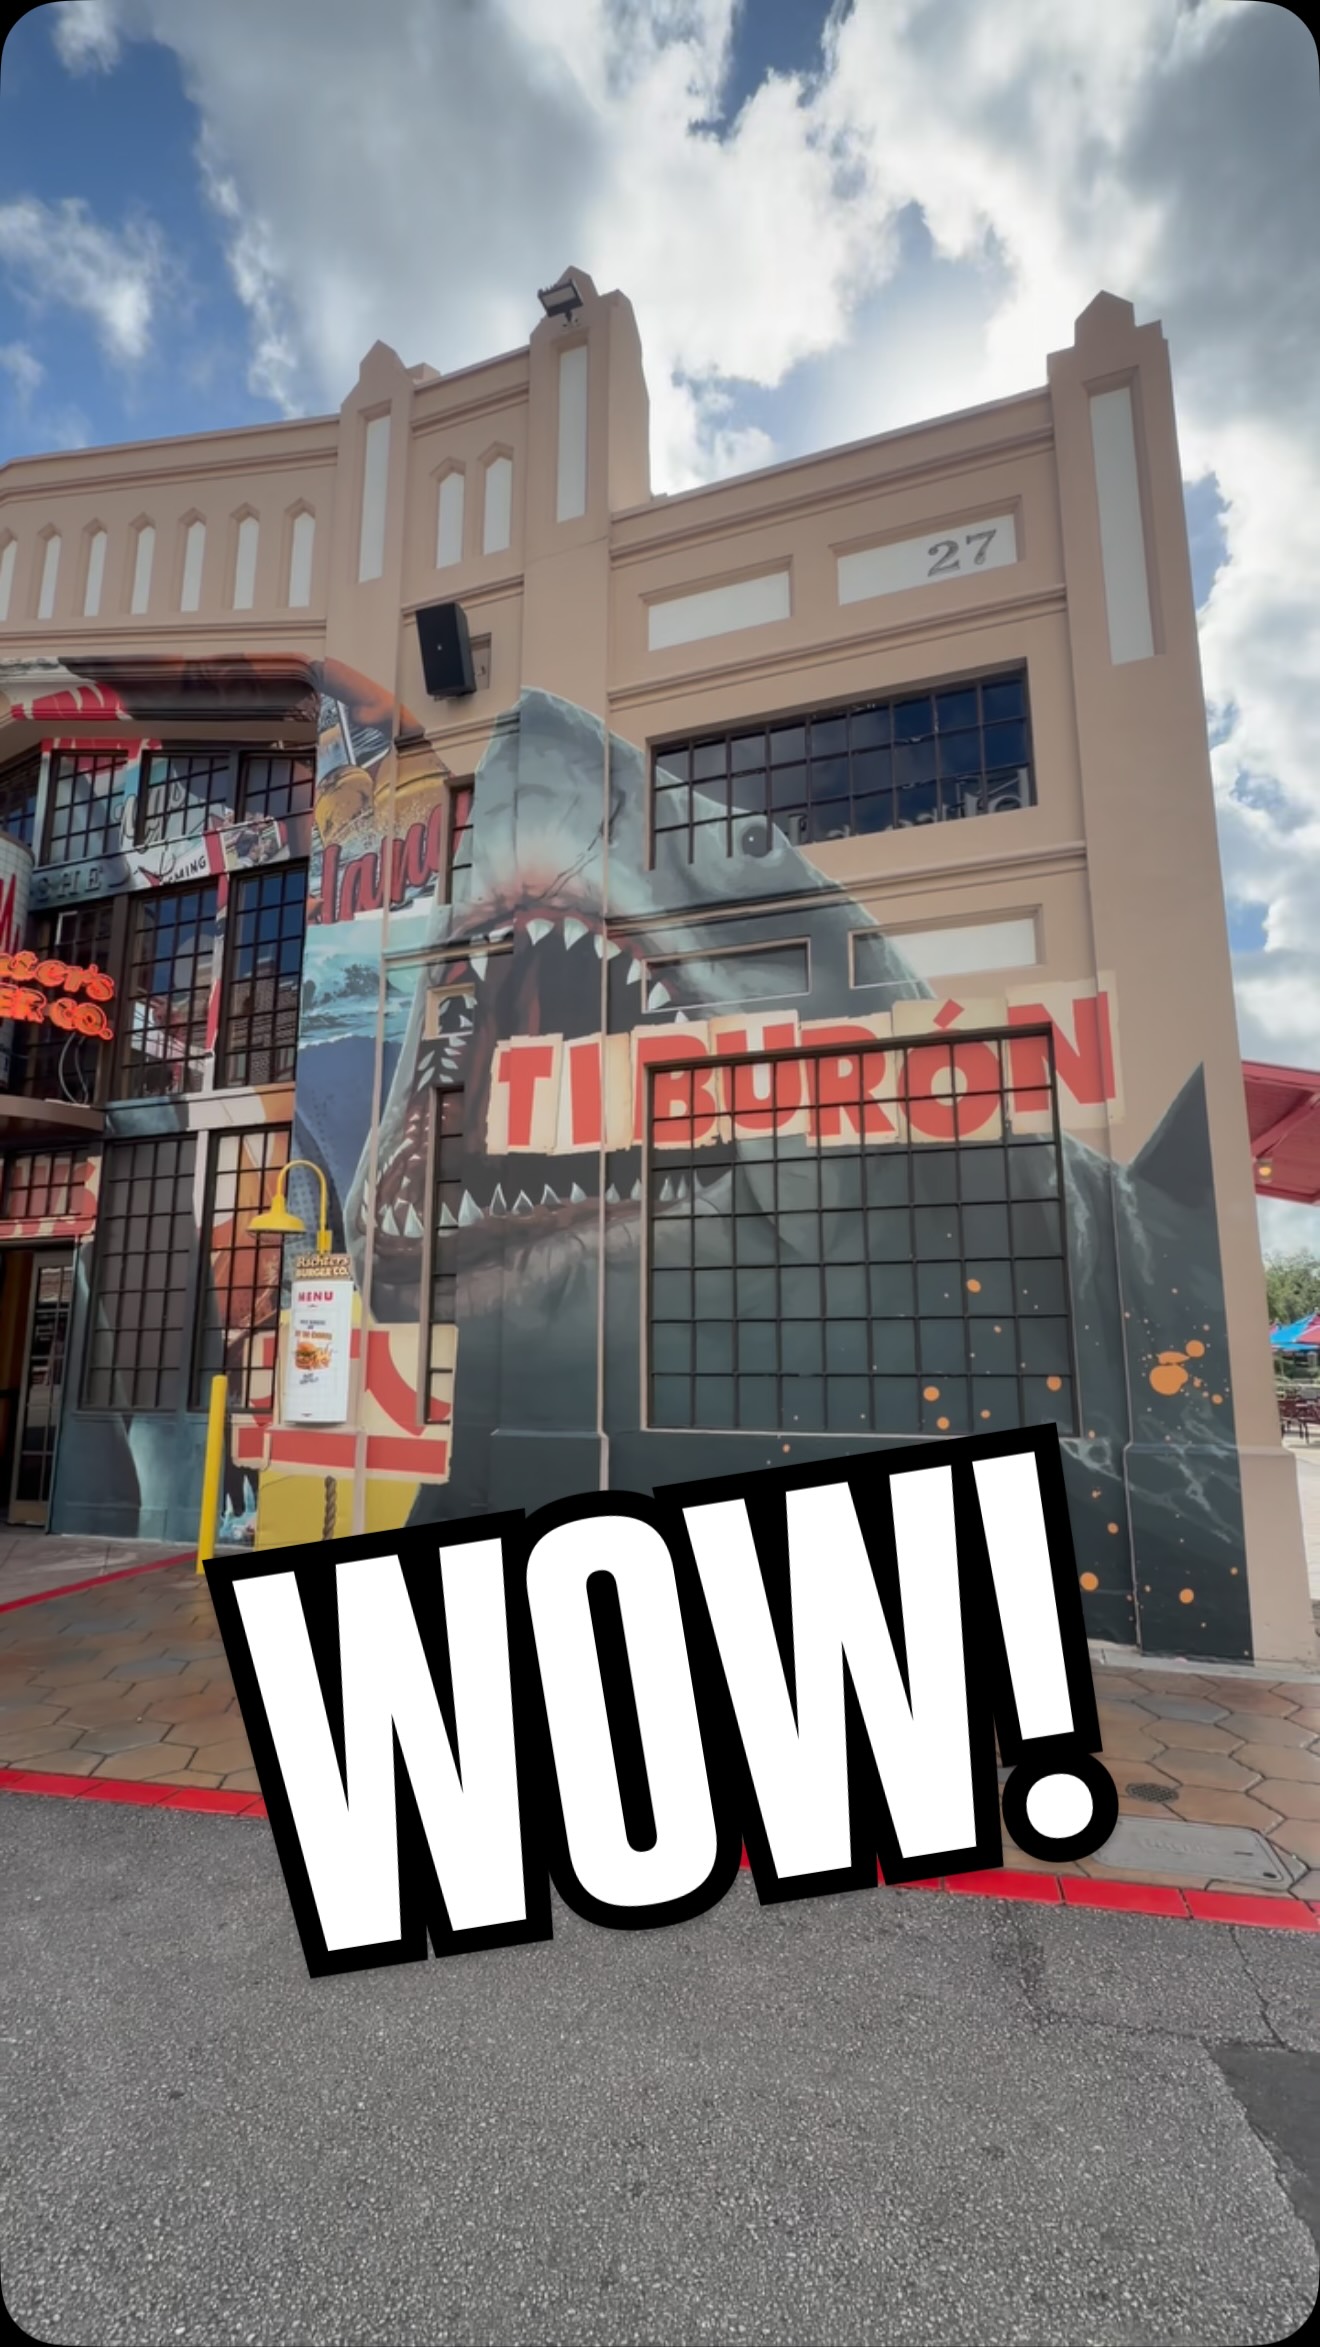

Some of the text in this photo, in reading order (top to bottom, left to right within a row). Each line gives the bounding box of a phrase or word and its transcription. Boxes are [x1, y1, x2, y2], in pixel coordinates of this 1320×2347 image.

[927, 528, 998, 578] 27
[498, 991, 1117, 1148] TIBURÓN
[298, 1291, 334, 1302] MENU
